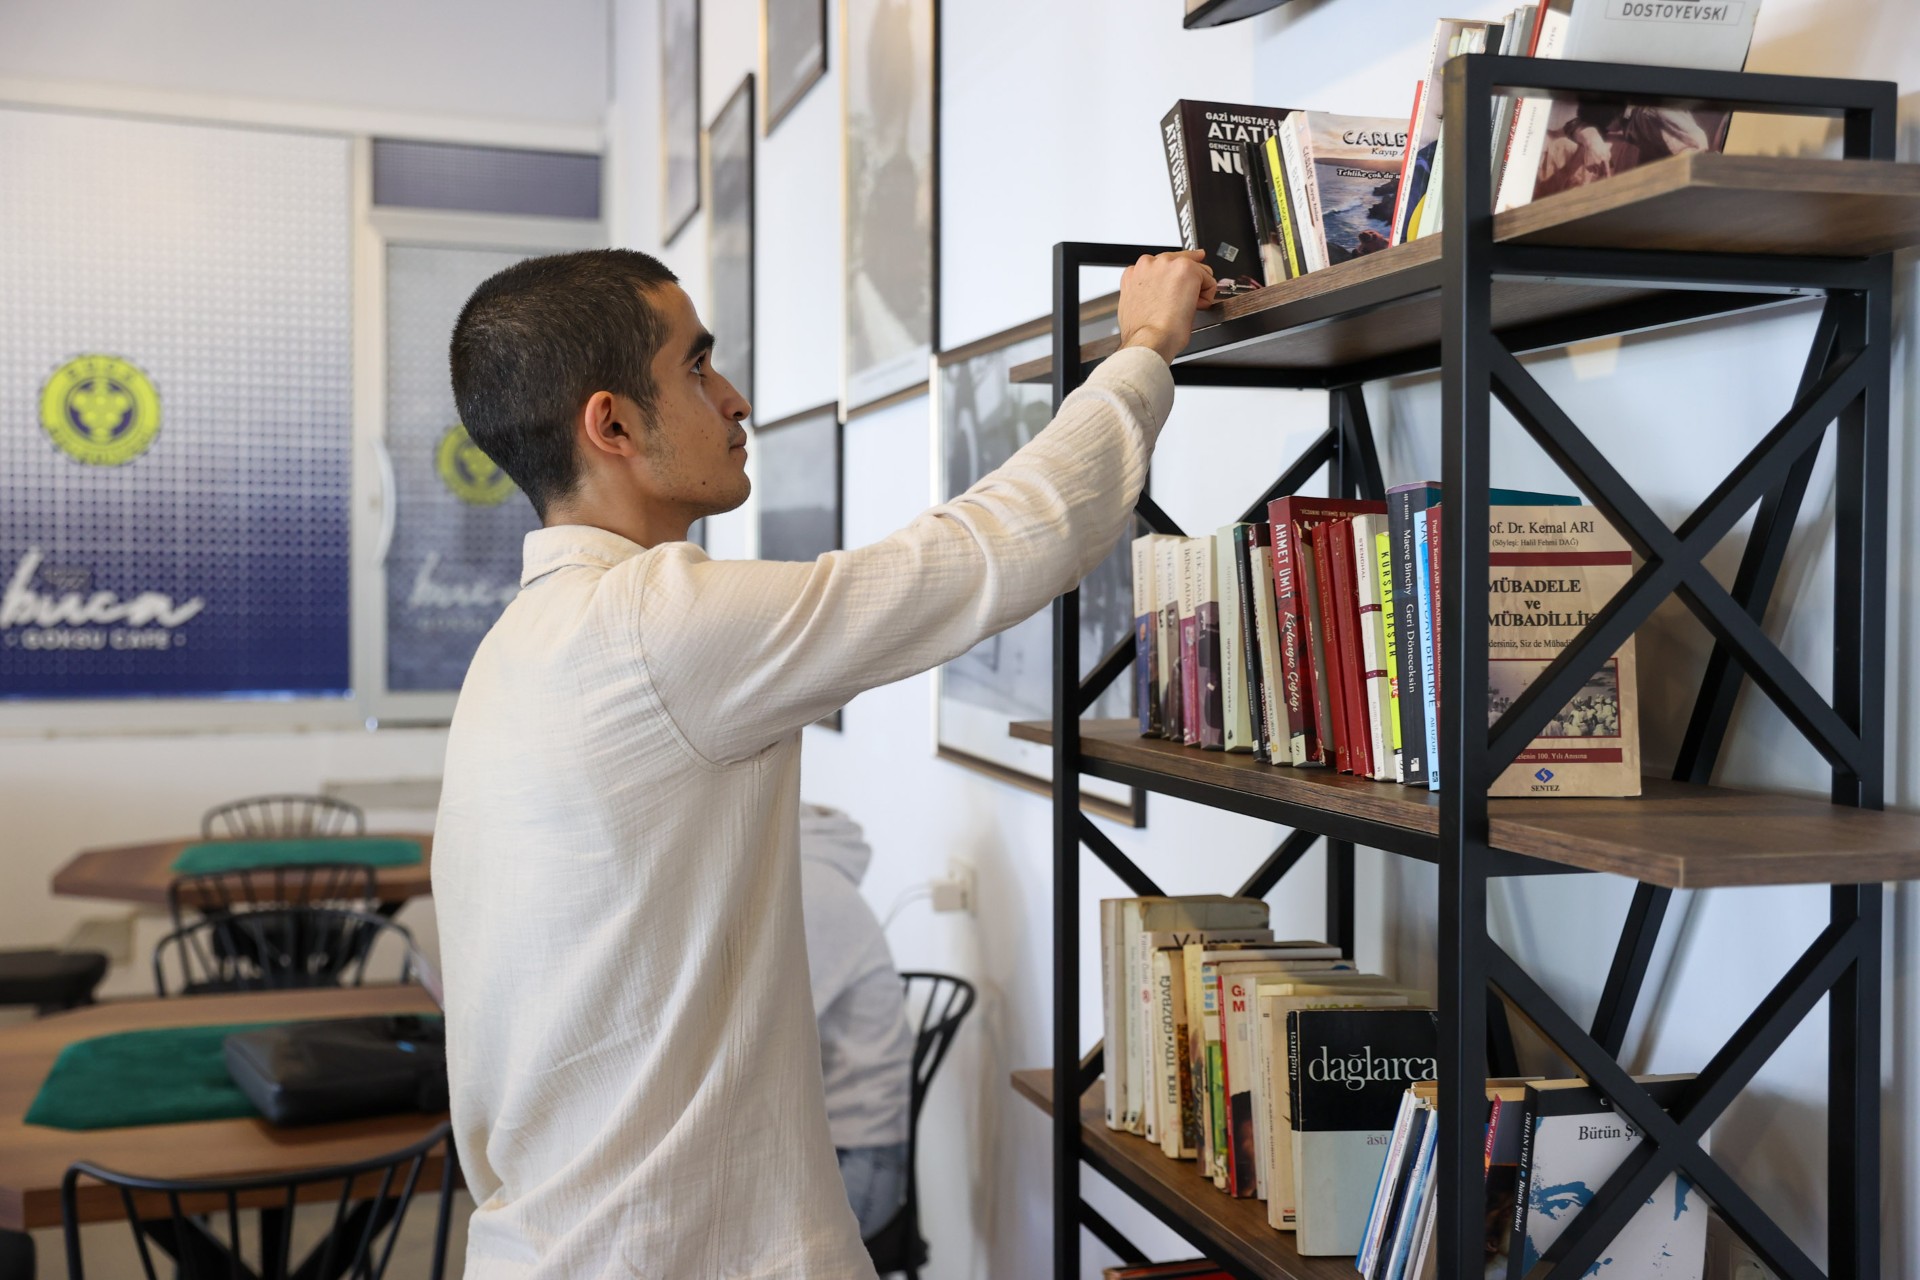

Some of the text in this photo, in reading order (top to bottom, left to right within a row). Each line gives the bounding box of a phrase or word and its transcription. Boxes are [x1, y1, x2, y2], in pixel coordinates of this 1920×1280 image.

[1205, 111, 1228, 121] GAZİ
[1229, 114, 1276, 128] MUSTAFA
[1207, 122, 1279, 143] ATATÜ
[1371, 147, 1399, 157] Kayıp
[1164, 122, 1185, 202] ATATÜRK
[1337, 168, 1367, 178] Tehlike
[1367, 171, 1382, 180] çok
[1508, 522, 1526, 534] Dr.
[1529, 521, 1567, 534] Kemal
[1569, 521, 1595, 534] ARI
[1520, 538, 1537, 546] Halil
[1558, 537, 1579, 547] DAĞ)
[1274, 523, 1292, 600] AHMET ÜMİT
[1403, 529, 1413, 595] Maeve Binchy
[1488, 576, 1582, 593] MÜBADELE
[1524, 600, 1541, 610] ve
[1405, 603, 1417, 693] Geri Döneceksin
[1520, 639, 1532, 648] Siz
[1533, 639, 1543, 648] de
[1165, 1041, 1176, 1067] TOY
[1308, 1045, 1438, 1091] dağlarca
[1522, 1111, 1532, 1146] ORHAN
[1578, 1125, 1621, 1141] Bütün
